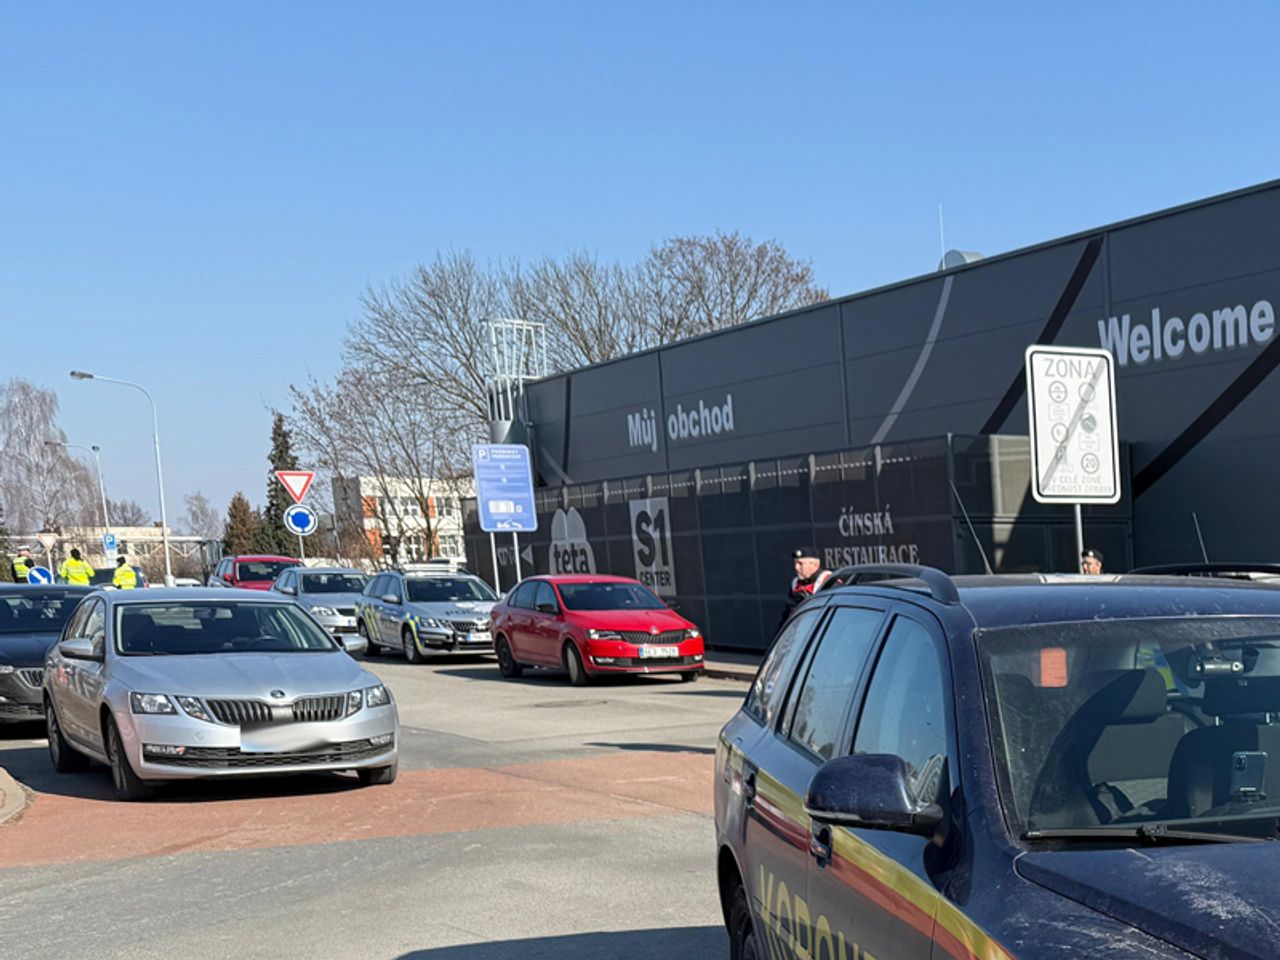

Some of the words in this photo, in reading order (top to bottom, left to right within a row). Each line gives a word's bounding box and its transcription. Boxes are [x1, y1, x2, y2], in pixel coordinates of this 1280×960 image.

[1098, 300, 1275, 366] Welcome
[627, 407, 658, 452] Můj
[667, 394, 735, 440] obchod
[1084, 457, 1097, 470] 20
[838, 504, 895, 537] ČÍNSKÁ
[635, 508, 670, 568] S1
[553, 543, 589, 574] teta
[825, 544, 920, 568] RESTAURACE
[640, 571, 672, 587] CENTER
